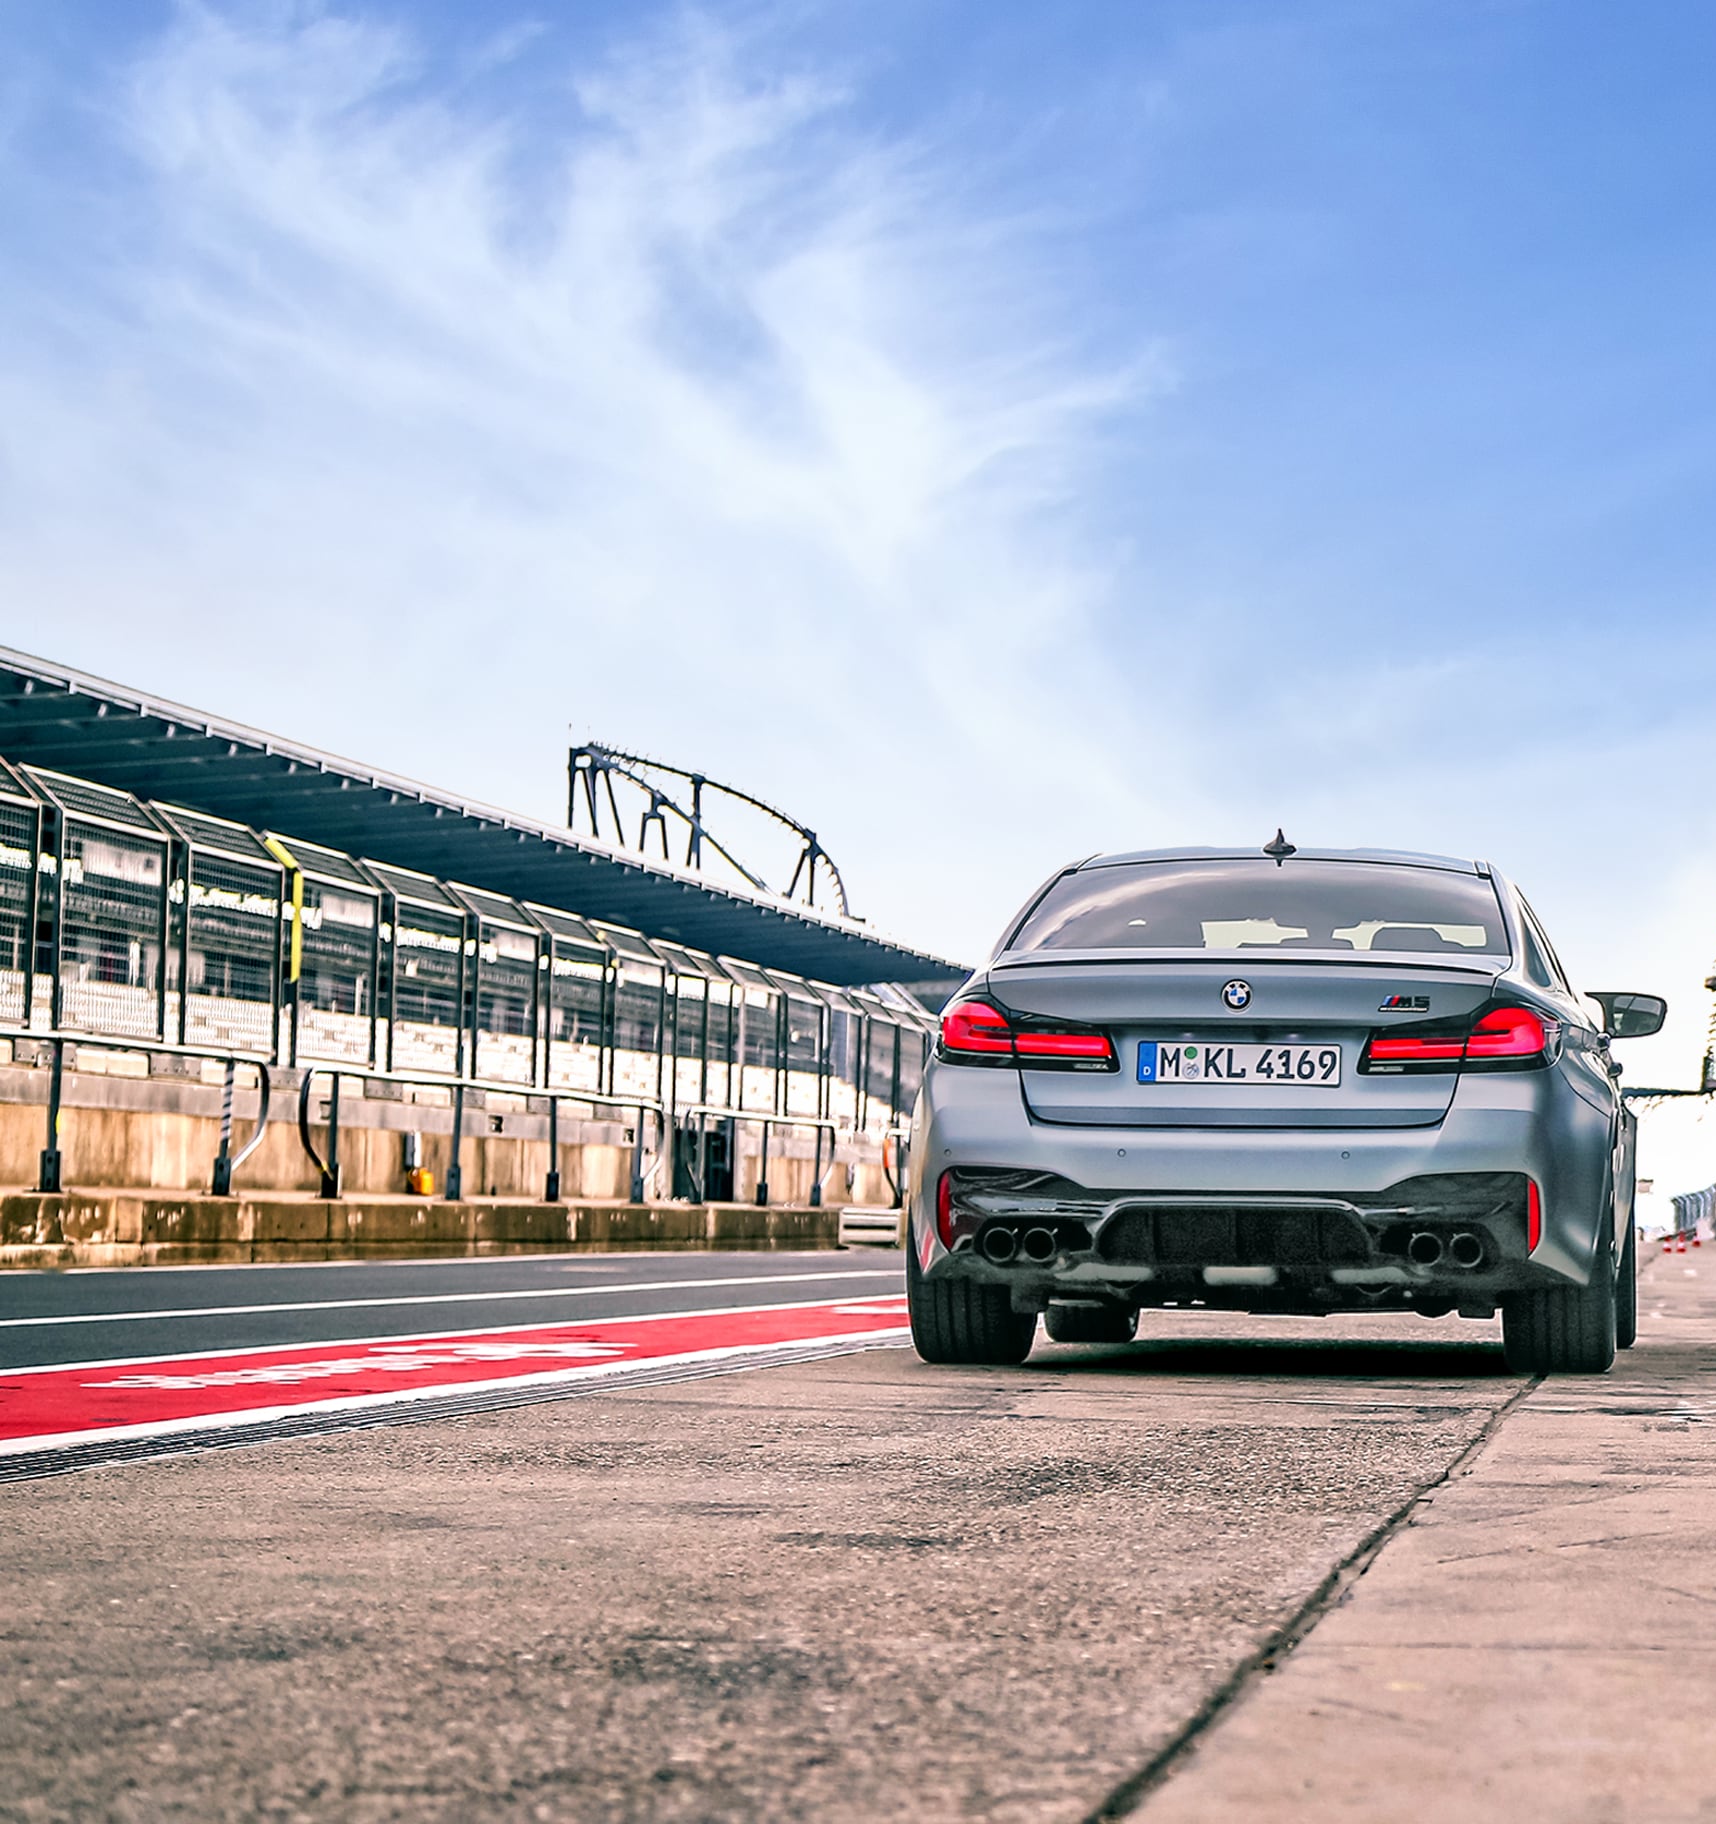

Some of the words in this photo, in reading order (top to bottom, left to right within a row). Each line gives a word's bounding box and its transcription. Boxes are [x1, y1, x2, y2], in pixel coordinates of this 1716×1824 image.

[1159, 1047, 1181, 1077] M
[1204, 1047, 1246, 1078] KL
[1256, 1048, 1337, 1080] 4169
